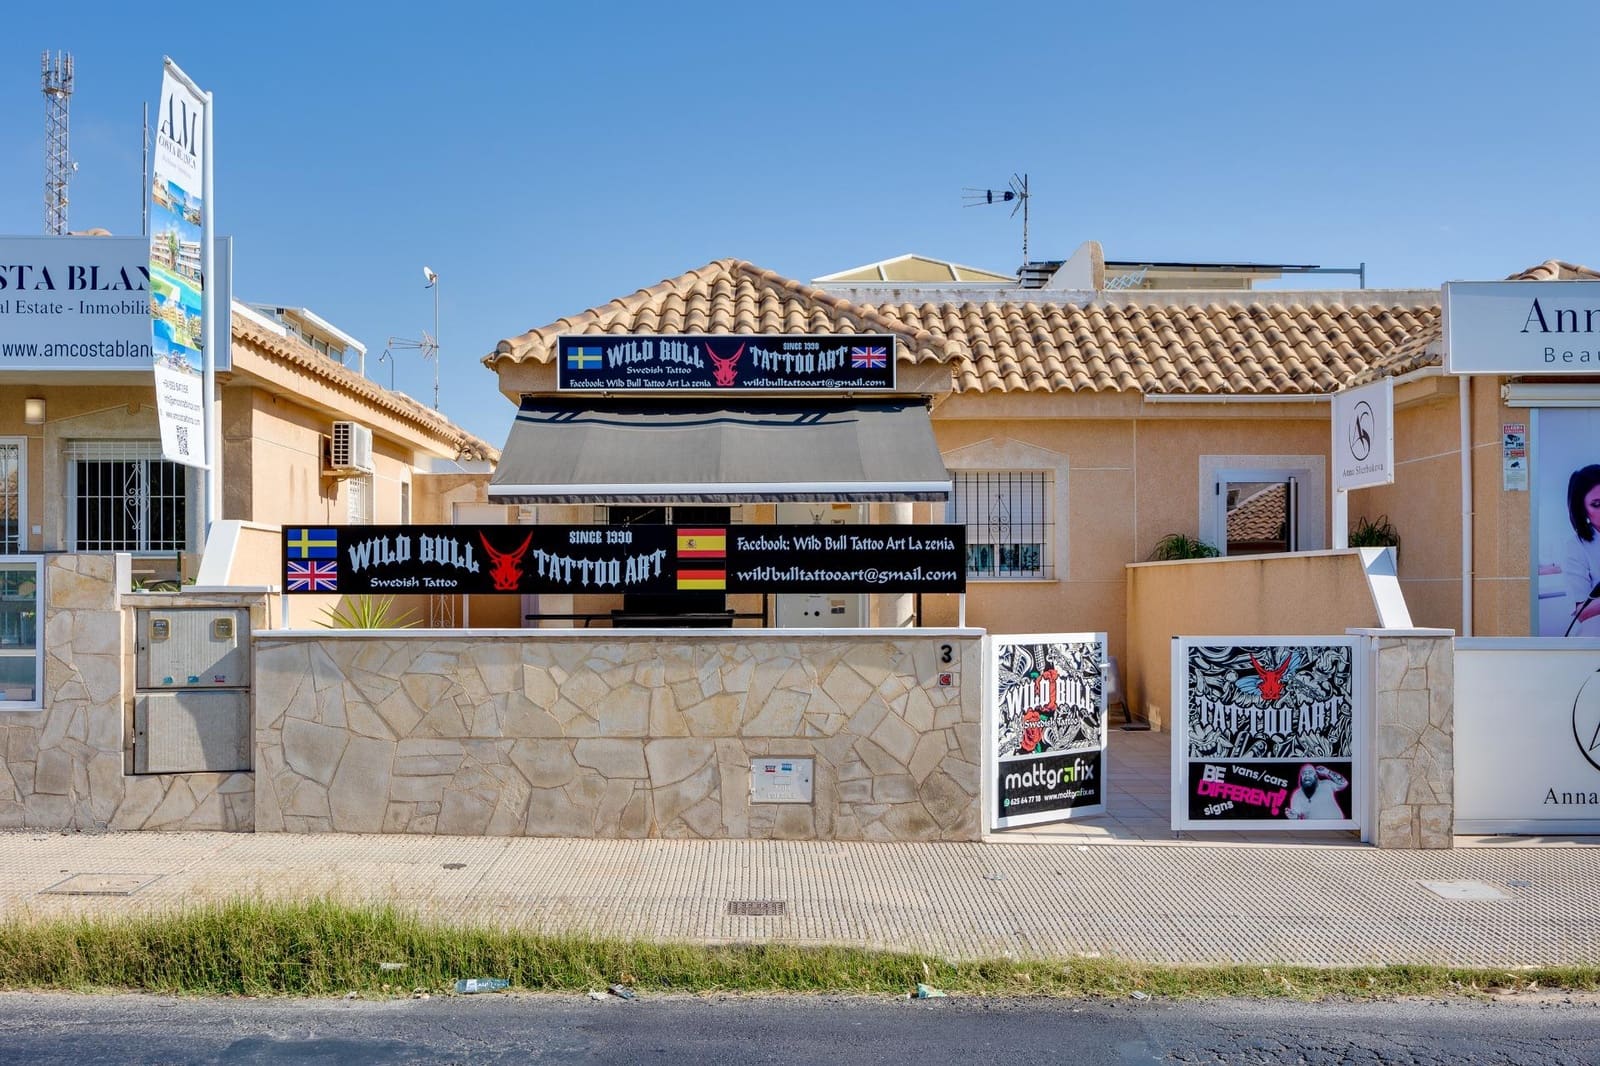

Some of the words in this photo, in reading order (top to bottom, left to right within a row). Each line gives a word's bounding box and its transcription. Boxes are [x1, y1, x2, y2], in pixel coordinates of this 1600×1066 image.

[16, 300, 63, 314] Estate
[606, 339, 654, 368] WILD
[659, 339, 704, 368] BULL
[783, 342, 802, 350] SINCE
[1544, 347, 1600, 363] Bea
[750, 346, 814, 374] TATTOO
[817, 345, 848, 372] ART
[626, 366, 663, 374] Swedish
[666, 366, 692, 374] Tattoo
[570, 379, 605, 388] Facebook:
[606, 378, 625, 387] Wild
[626, 379, 642, 387] Bull
[643, 379, 666, 387] Tattoo
[667, 379, 680, 387] Art
[743, 378, 886, 388] wildbulltattooart@gmail.com
[569, 530, 602, 544] SINCE
[737, 535, 790, 551] Facebook:
[793, 534, 821, 551] Wild
[824, 534, 847, 550] Bull
[850, 536, 884, 551] Tattoo
[885, 536, 906, 550] Art
[348, 533, 411, 574] WILD
[419, 533, 480, 574] BULL
[533, 548, 621, 588] TATTOO
[624, 548, 667, 586] ART
[737, 566, 957, 584] wildbulltattooart@gmail.com
[370, 576, 420, 588] Swedish
[422, 577, 458, 588] Tattoo
[940, 644, 953, 663] 3
[1005, 677, 1051, 720] WILD
[1056, 677, 1094, 715] BULL
[1024, 717, 1056, 729] Swedish
[1195, 694, 1293, 738] TATTOO
[1297, 694, 1345, 736] ART
[1005, 758, 1094, 790] mattgrafix
[1202, 764, 1227, 783] BE
[1231, 764, 1289, 788] vans/cars
[1197, 779, 1288, 816] DIFFERENT!
[1543, 787, 1599, 805] Anna
[1203, 800, 1235, 816] signs
